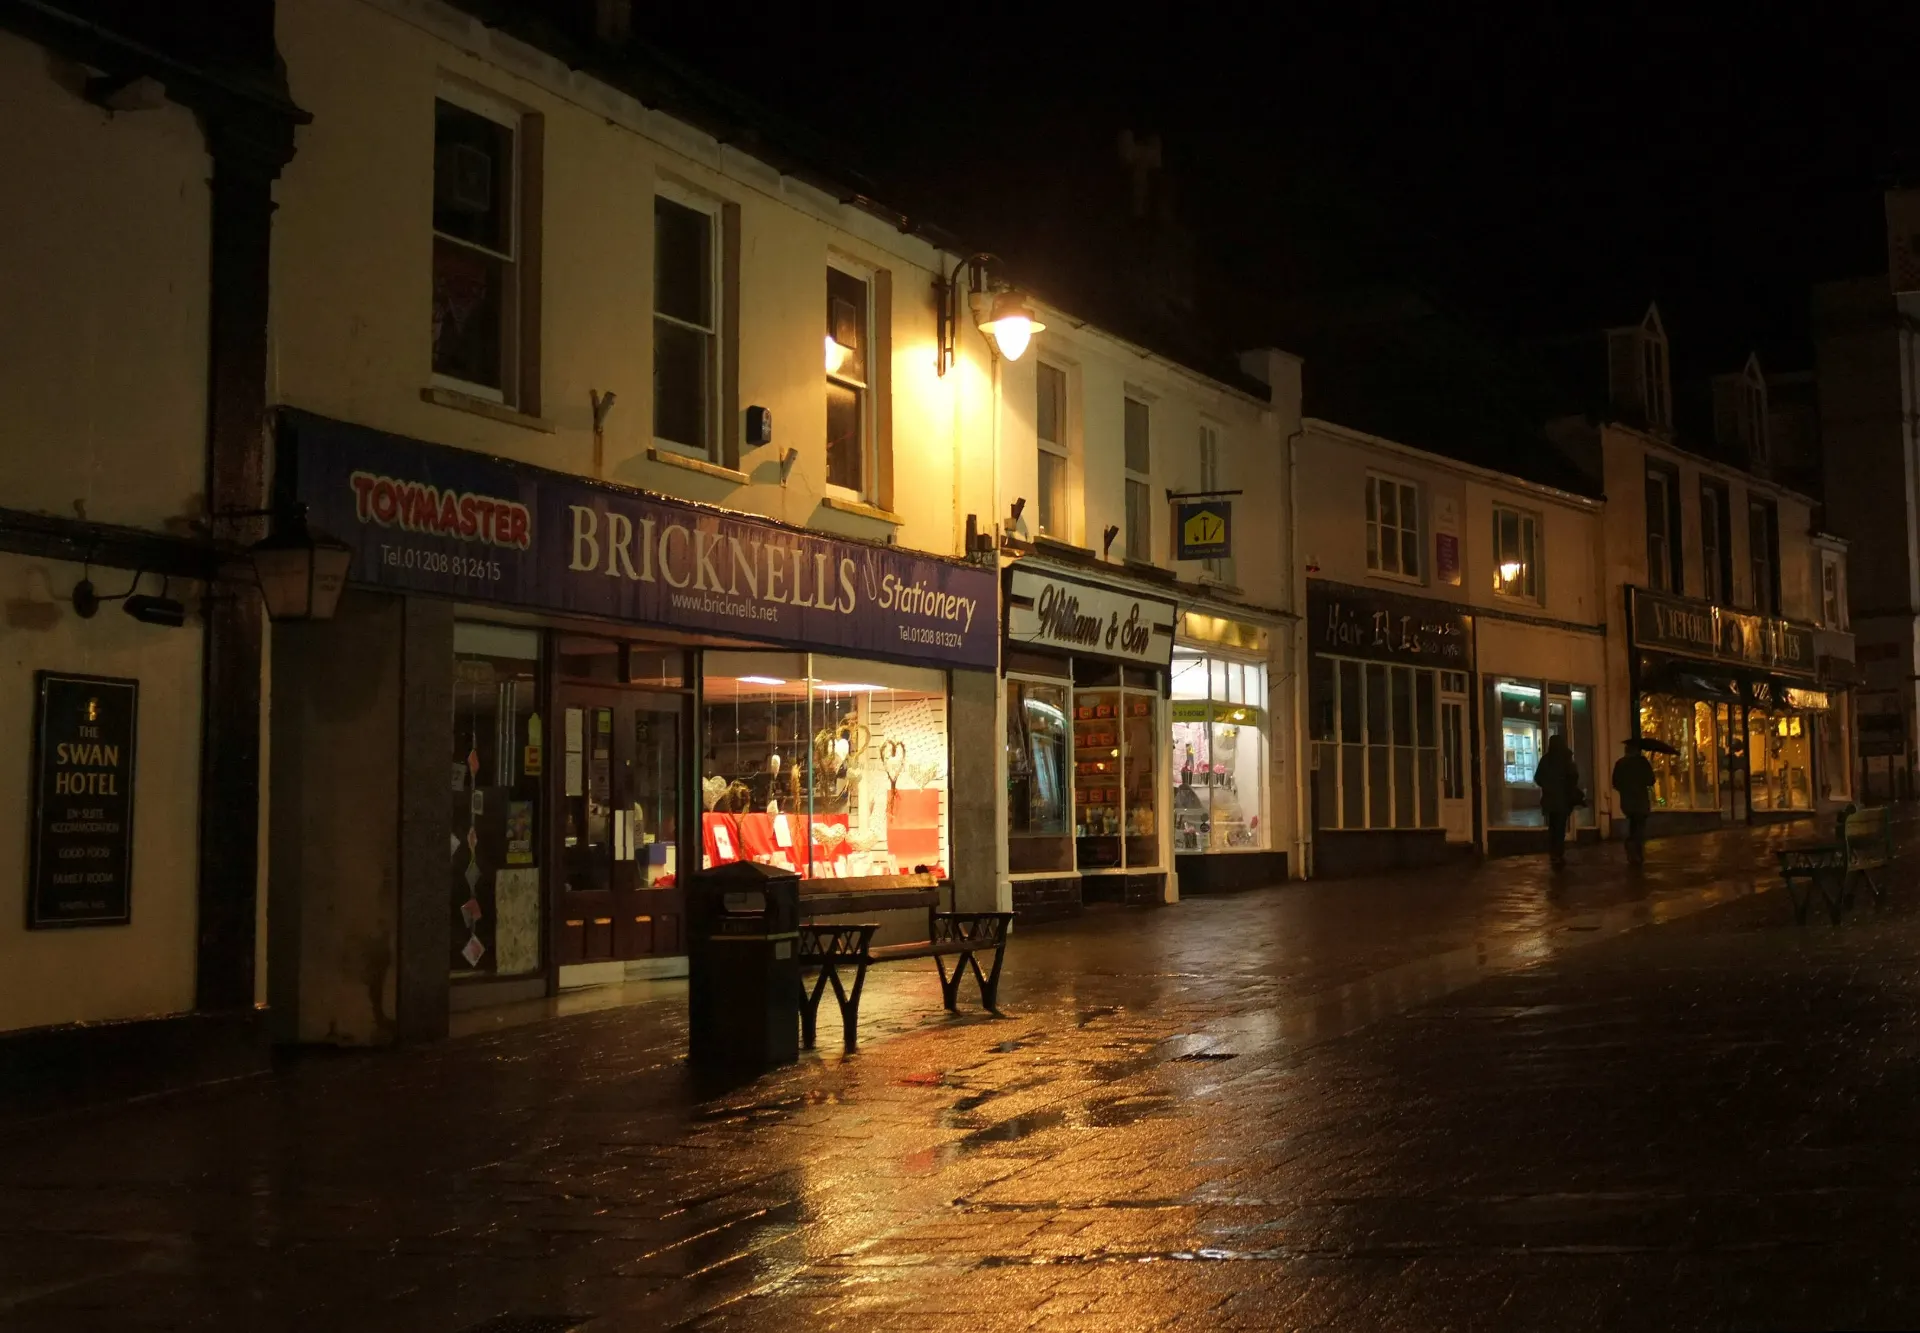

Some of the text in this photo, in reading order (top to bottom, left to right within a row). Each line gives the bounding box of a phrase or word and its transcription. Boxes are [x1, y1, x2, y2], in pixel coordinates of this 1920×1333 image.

[350, 470, 531, 550] TOYMASTER
[381, 544, 501, 581] Tel.01208 812615
[568, 504, 856, 614] BRICKNELLS
[671, 591, 779, 624] www.bricknells.net
[878, 573, 977, 633] Stationery
[1038, 583, 1149, 655] Williams & Son
[898, 625, 962, 649] Tel.01208 813274
[1325, 602, 1365, 647] Hair
[77, 725, 99, 739] THE
[56, 742, 120, 767] SWAN
[55, 772, 118, 796] HOTEL
